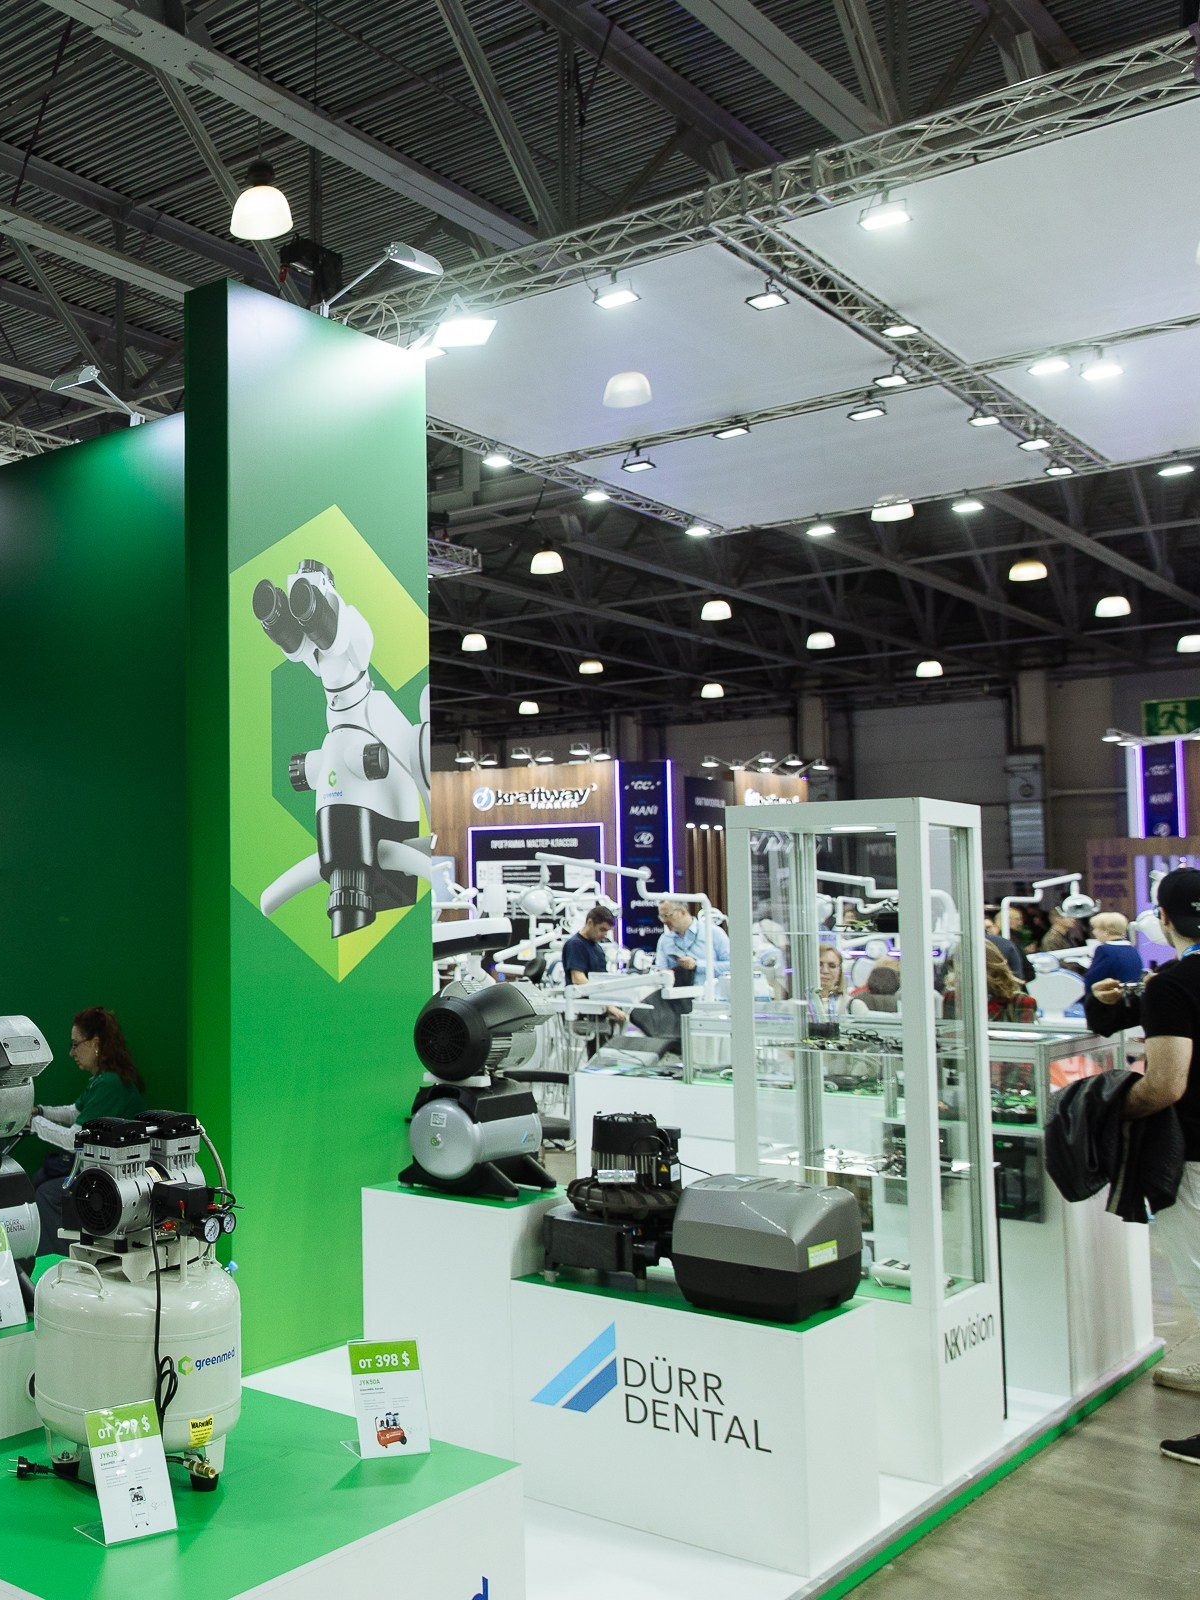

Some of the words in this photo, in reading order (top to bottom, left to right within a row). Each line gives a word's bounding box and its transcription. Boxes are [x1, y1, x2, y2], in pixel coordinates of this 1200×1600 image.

[495, 787, 591, 806] kraftway
[195, 1347, 236, 1371] greenmed
[375, 1353, 399, 1368] 398
[401, 1350, 411, 1368] $
[623, 1356, 725, 1406] DÜRR
[141, 1414, 151, 1433] $
[624, 1393, 772, 1454] DENTAL
